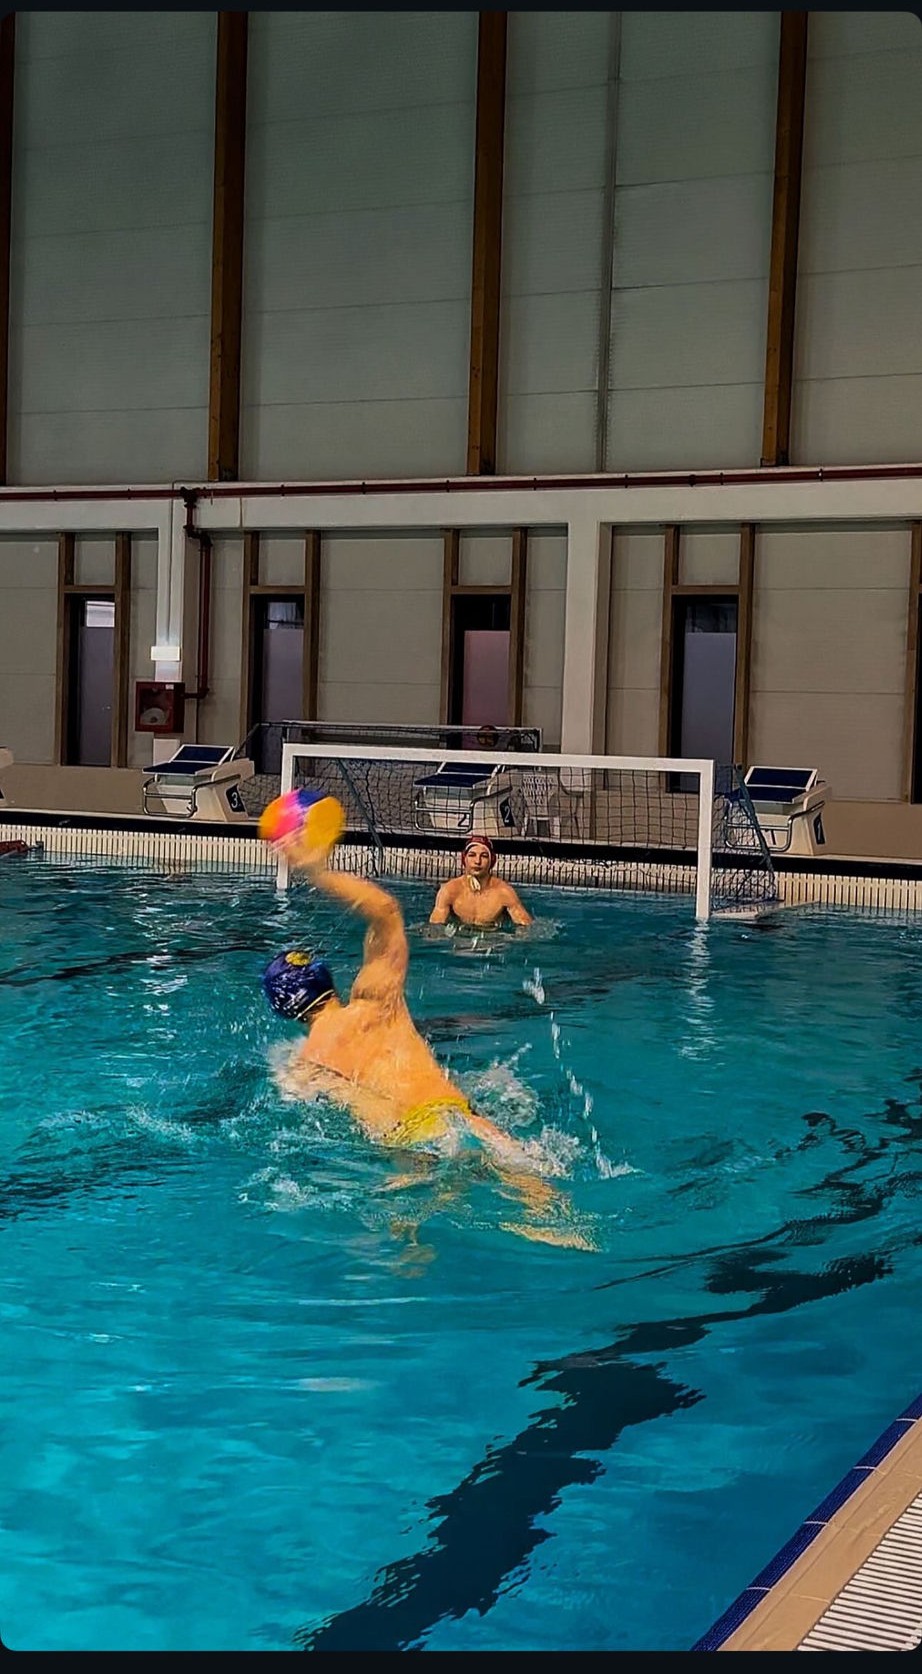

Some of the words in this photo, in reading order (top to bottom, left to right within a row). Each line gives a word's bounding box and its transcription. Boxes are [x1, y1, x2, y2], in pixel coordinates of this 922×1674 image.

[231, 791, 238, 808] 3
[457, 811, 470, 827] 2
[504, 805, 511, 823] 2
